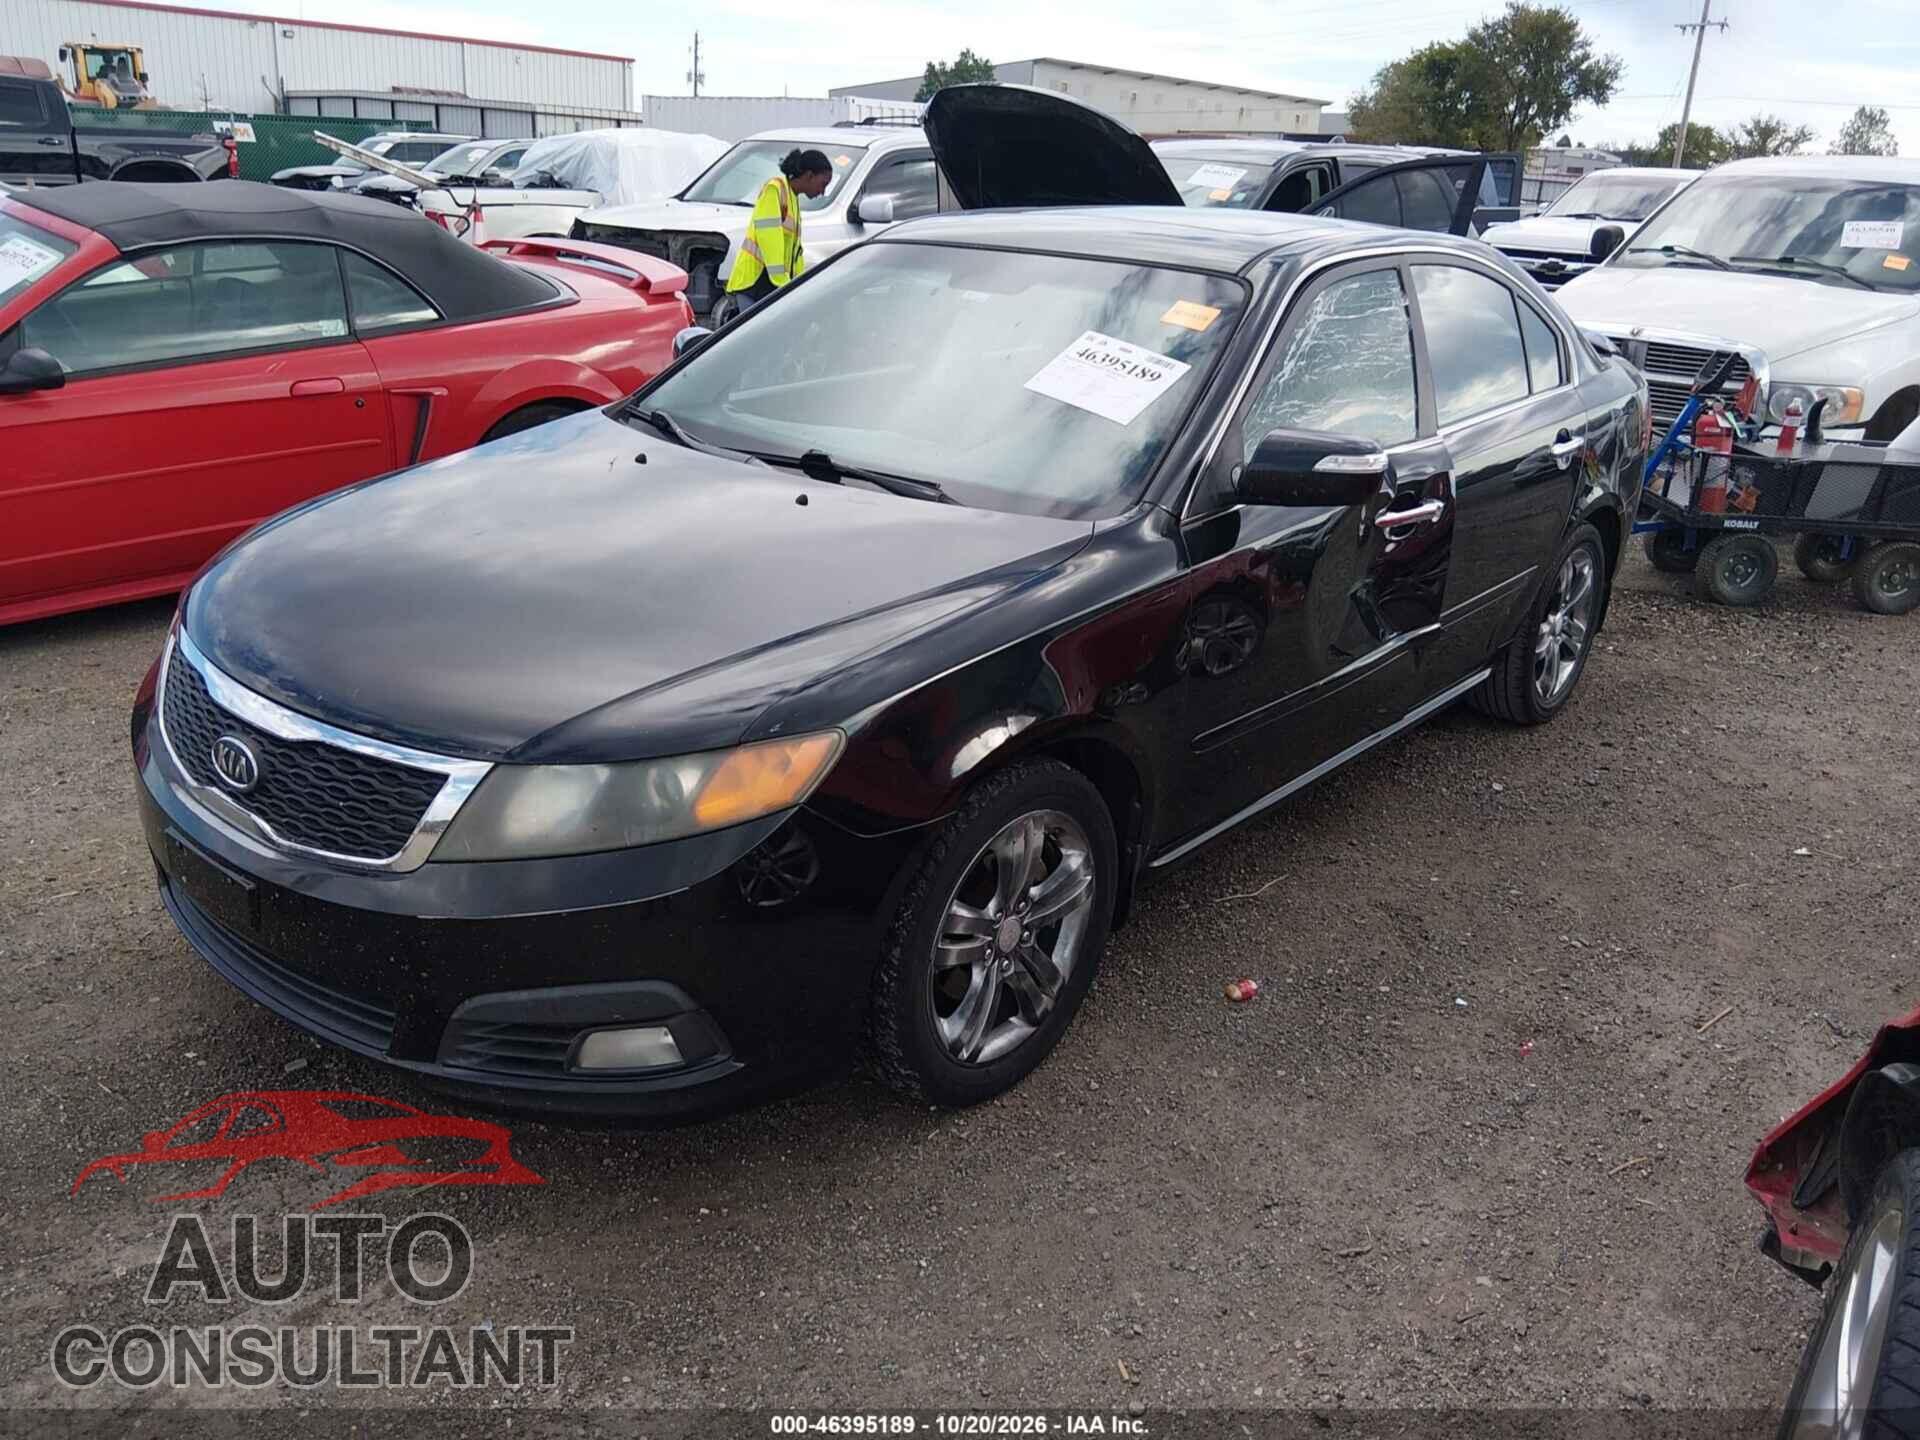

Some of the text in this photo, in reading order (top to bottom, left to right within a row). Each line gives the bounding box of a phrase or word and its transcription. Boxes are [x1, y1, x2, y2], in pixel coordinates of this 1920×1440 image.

[1076, 347, 1162, 382] 46395189
[1723, 519, 1760, 529] KOBALT
[217, 742, 248, 783] KIA
